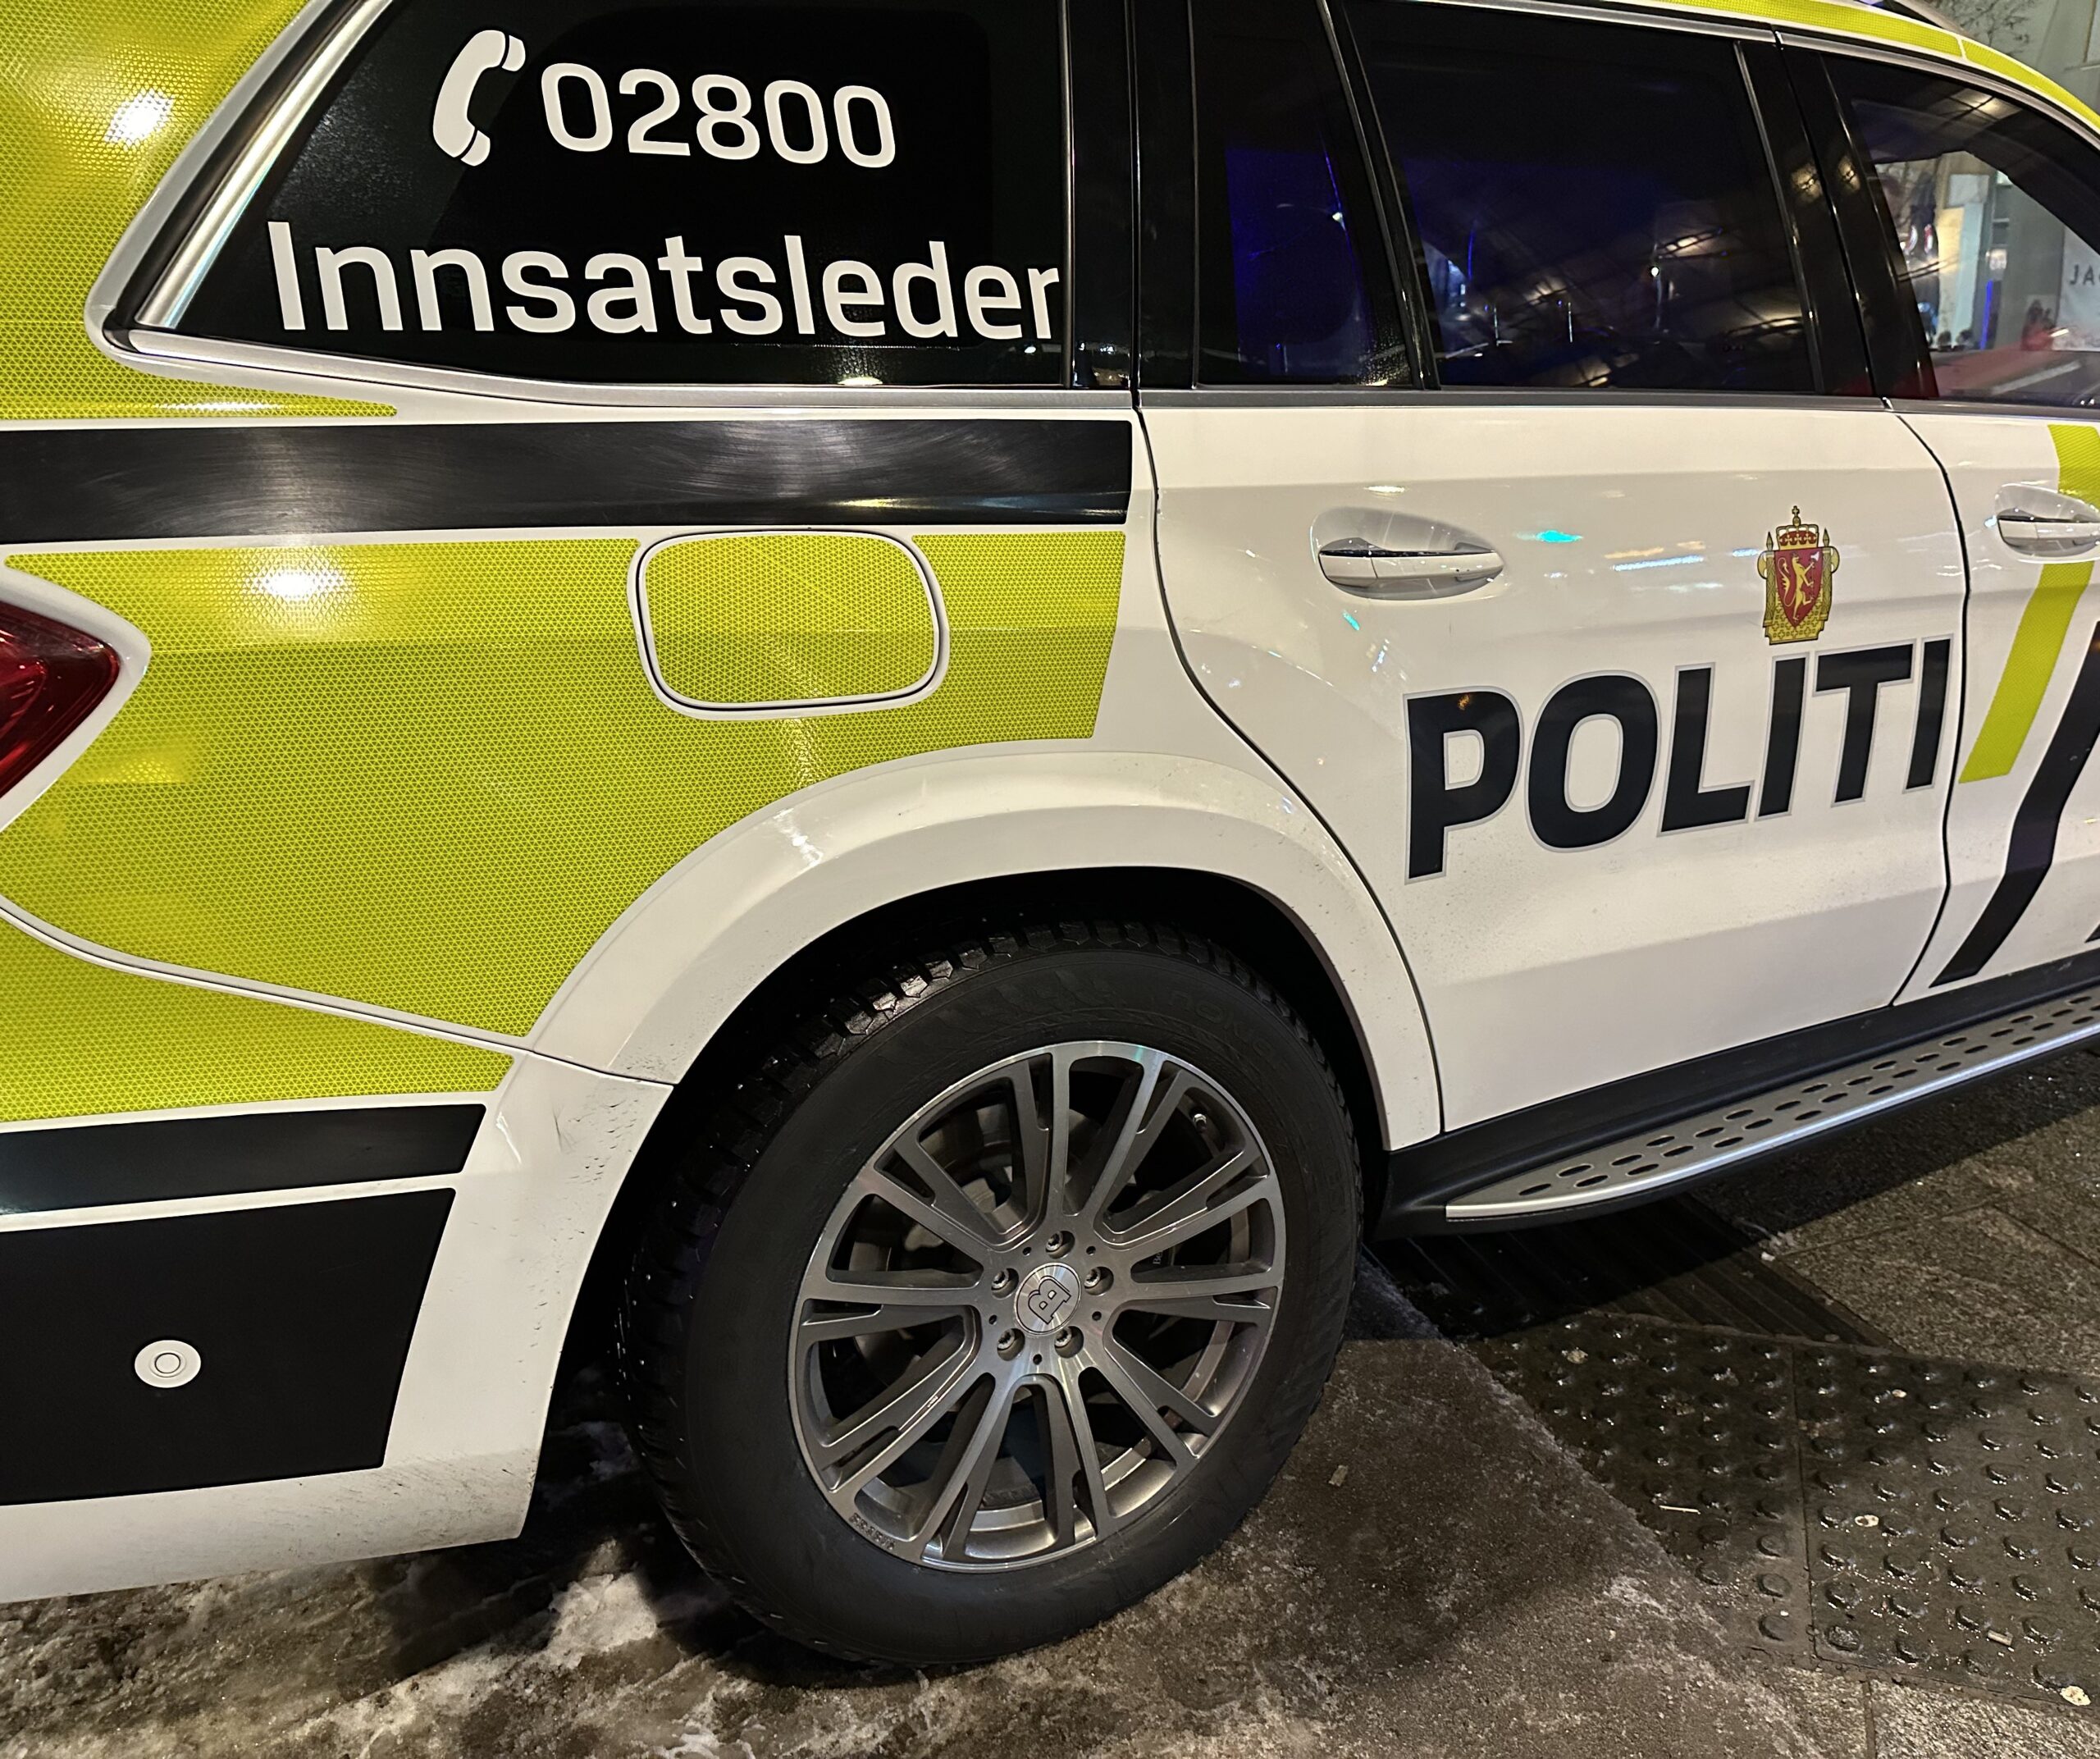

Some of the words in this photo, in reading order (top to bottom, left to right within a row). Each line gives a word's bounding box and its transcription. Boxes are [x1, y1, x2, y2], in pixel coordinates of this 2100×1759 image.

[541, 62, 896, 168] 02800
[267, 221, 1060, 340] Innsatsleder
[2069, 263, 2100, 286] JA
[1405, 636, 1952, 881] POLITI
[1028, 1275, 1071, 1325] B
